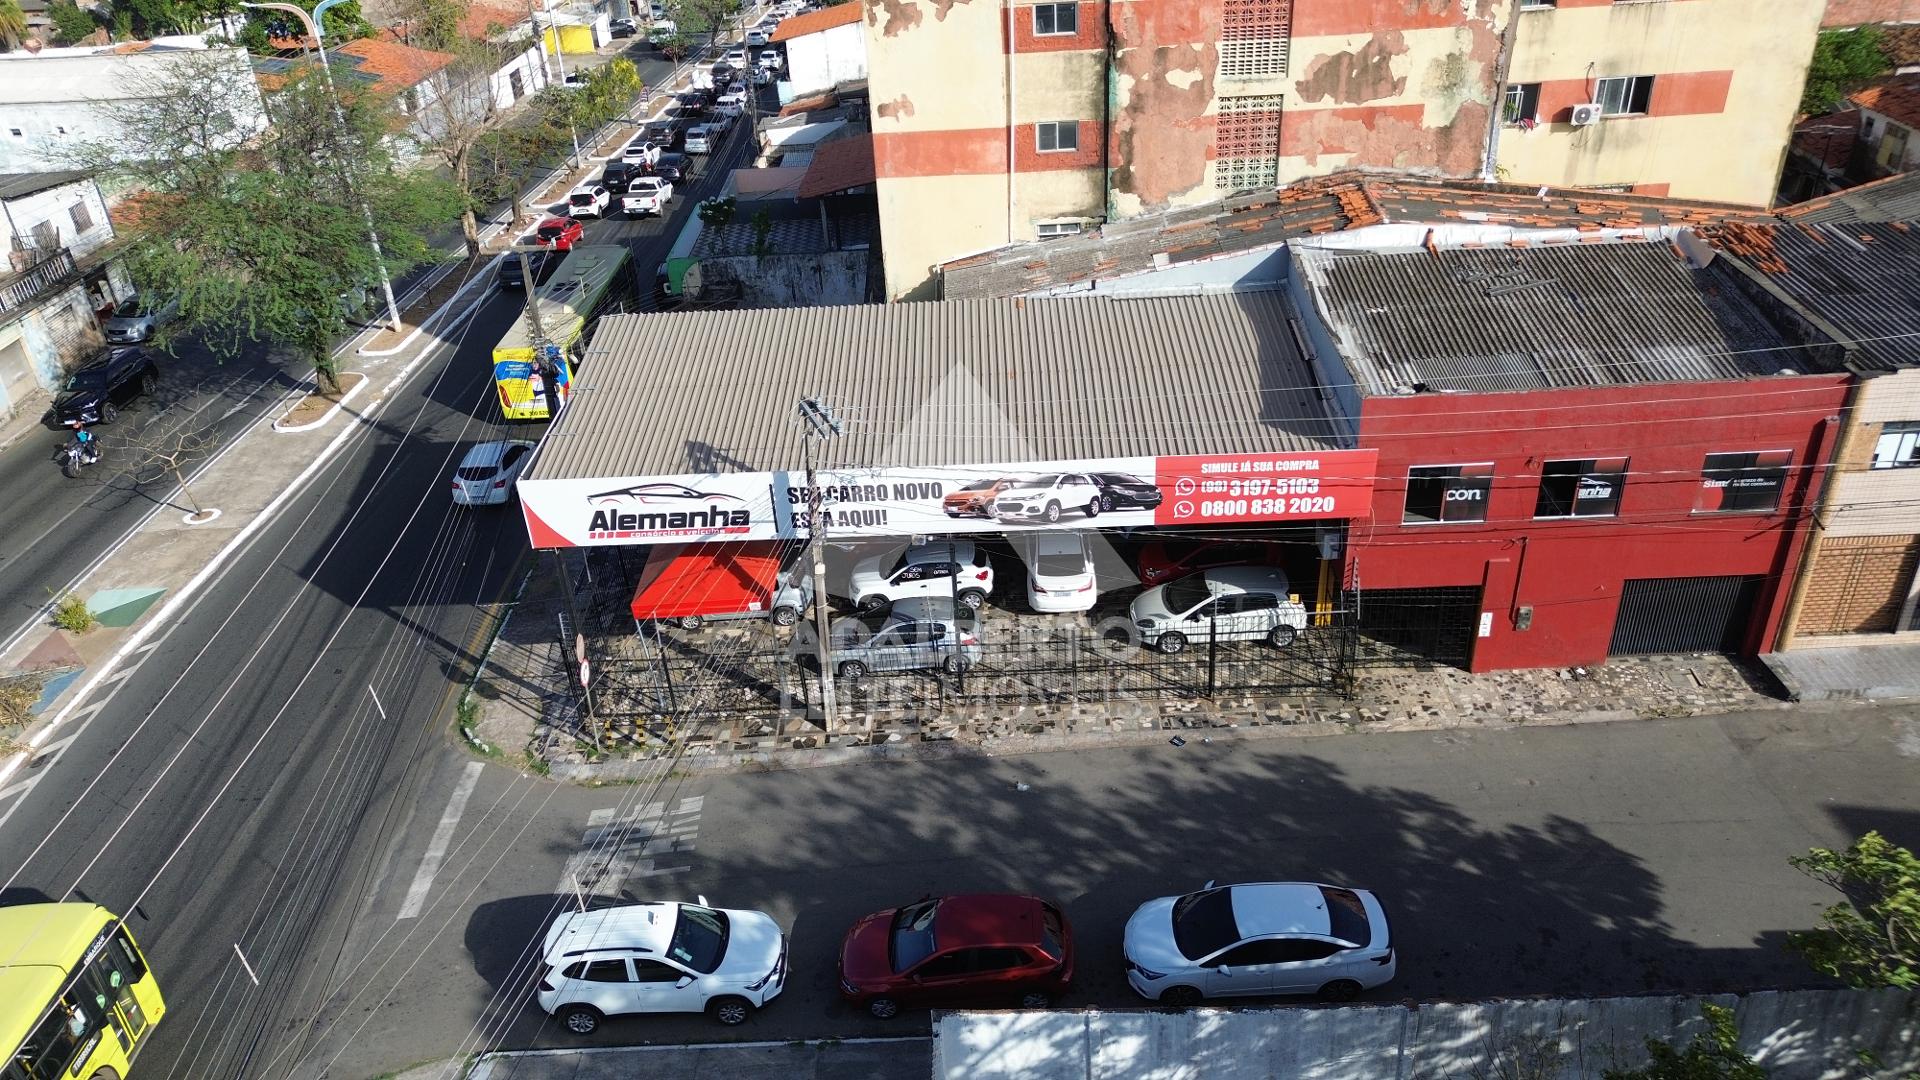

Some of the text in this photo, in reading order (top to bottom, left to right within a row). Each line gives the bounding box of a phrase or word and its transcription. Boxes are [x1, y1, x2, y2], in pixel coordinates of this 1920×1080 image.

[1201, 459, 1319, 474] SIMULE JÁ SUA COMPRA
[826, 484, 888, 502] CARRO
[893, 481, 943, 500] NOVO
[1229, 478, 1320, 496] 3197-5103
[1201, 496, 1335, 517] 0800 838 2020
[588, 505, 750, 532] Alemanha
[838, 509, 888, 528] AQUI!
[630, 528, 676, 538] consórcio
